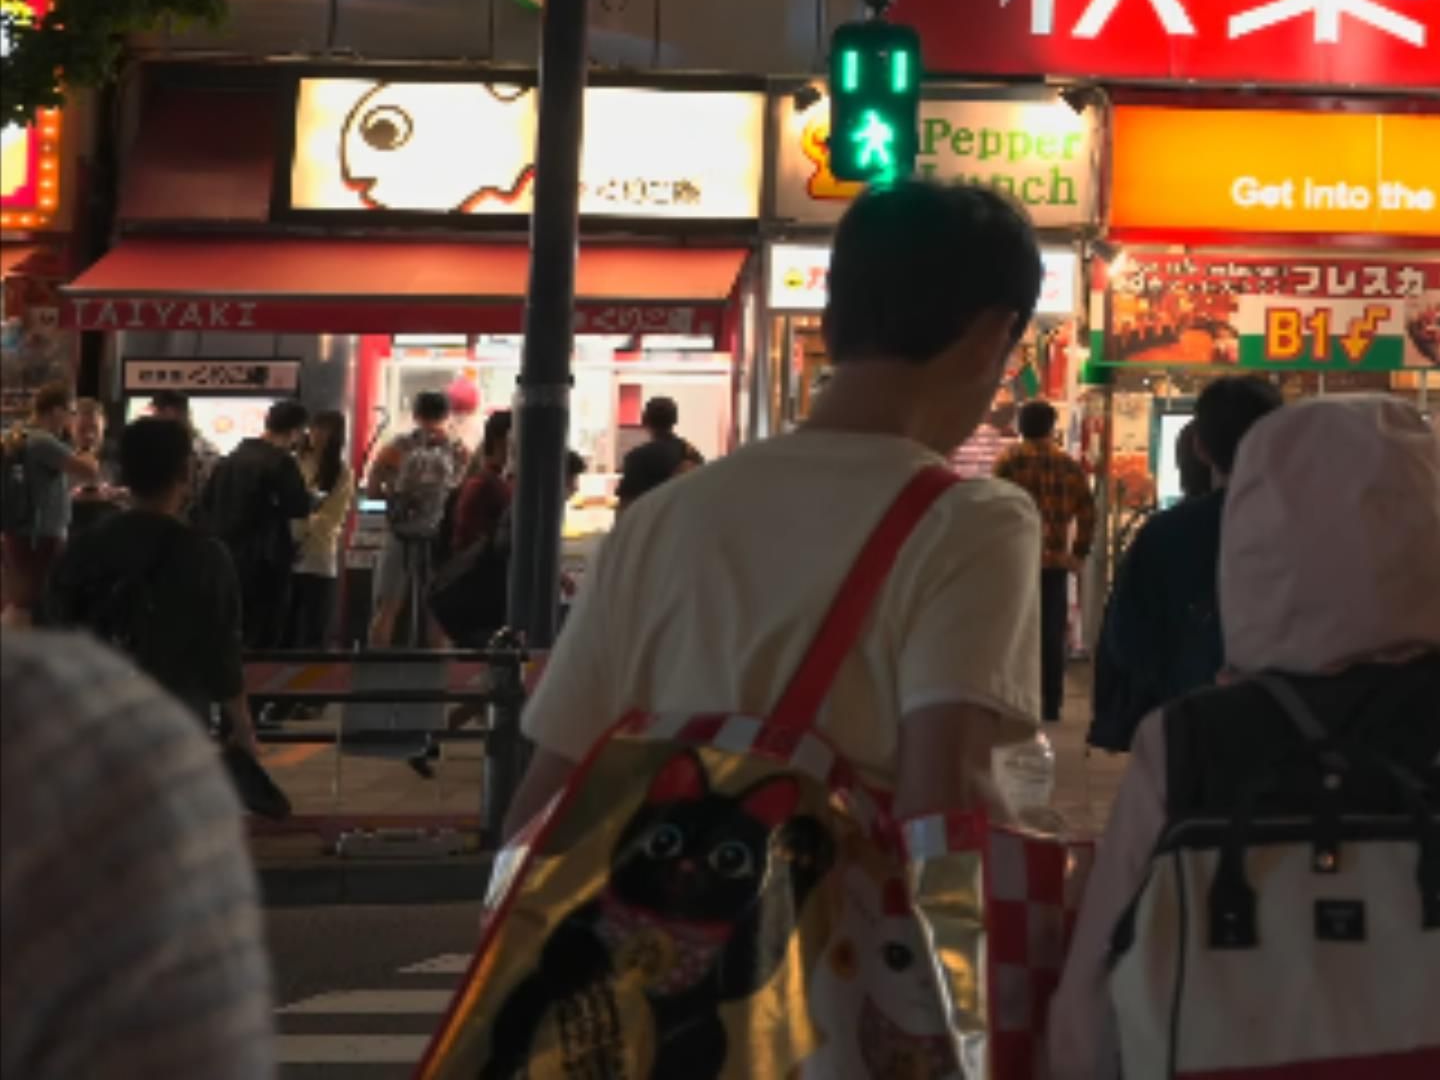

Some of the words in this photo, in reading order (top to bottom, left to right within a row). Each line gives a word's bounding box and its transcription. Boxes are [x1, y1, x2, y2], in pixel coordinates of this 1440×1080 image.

[920, 118, 1081, 161] Pepper
[1230, 176, 1293, 207] Get
[1304, 179, 1369, 209] into
[1379, 181, 1434, 212] the
[1292, 263, 1424, 296] フレスカ
[71, 297, 257, 327] TAIYAKI
[1265, 306, 1331, 360] B1
